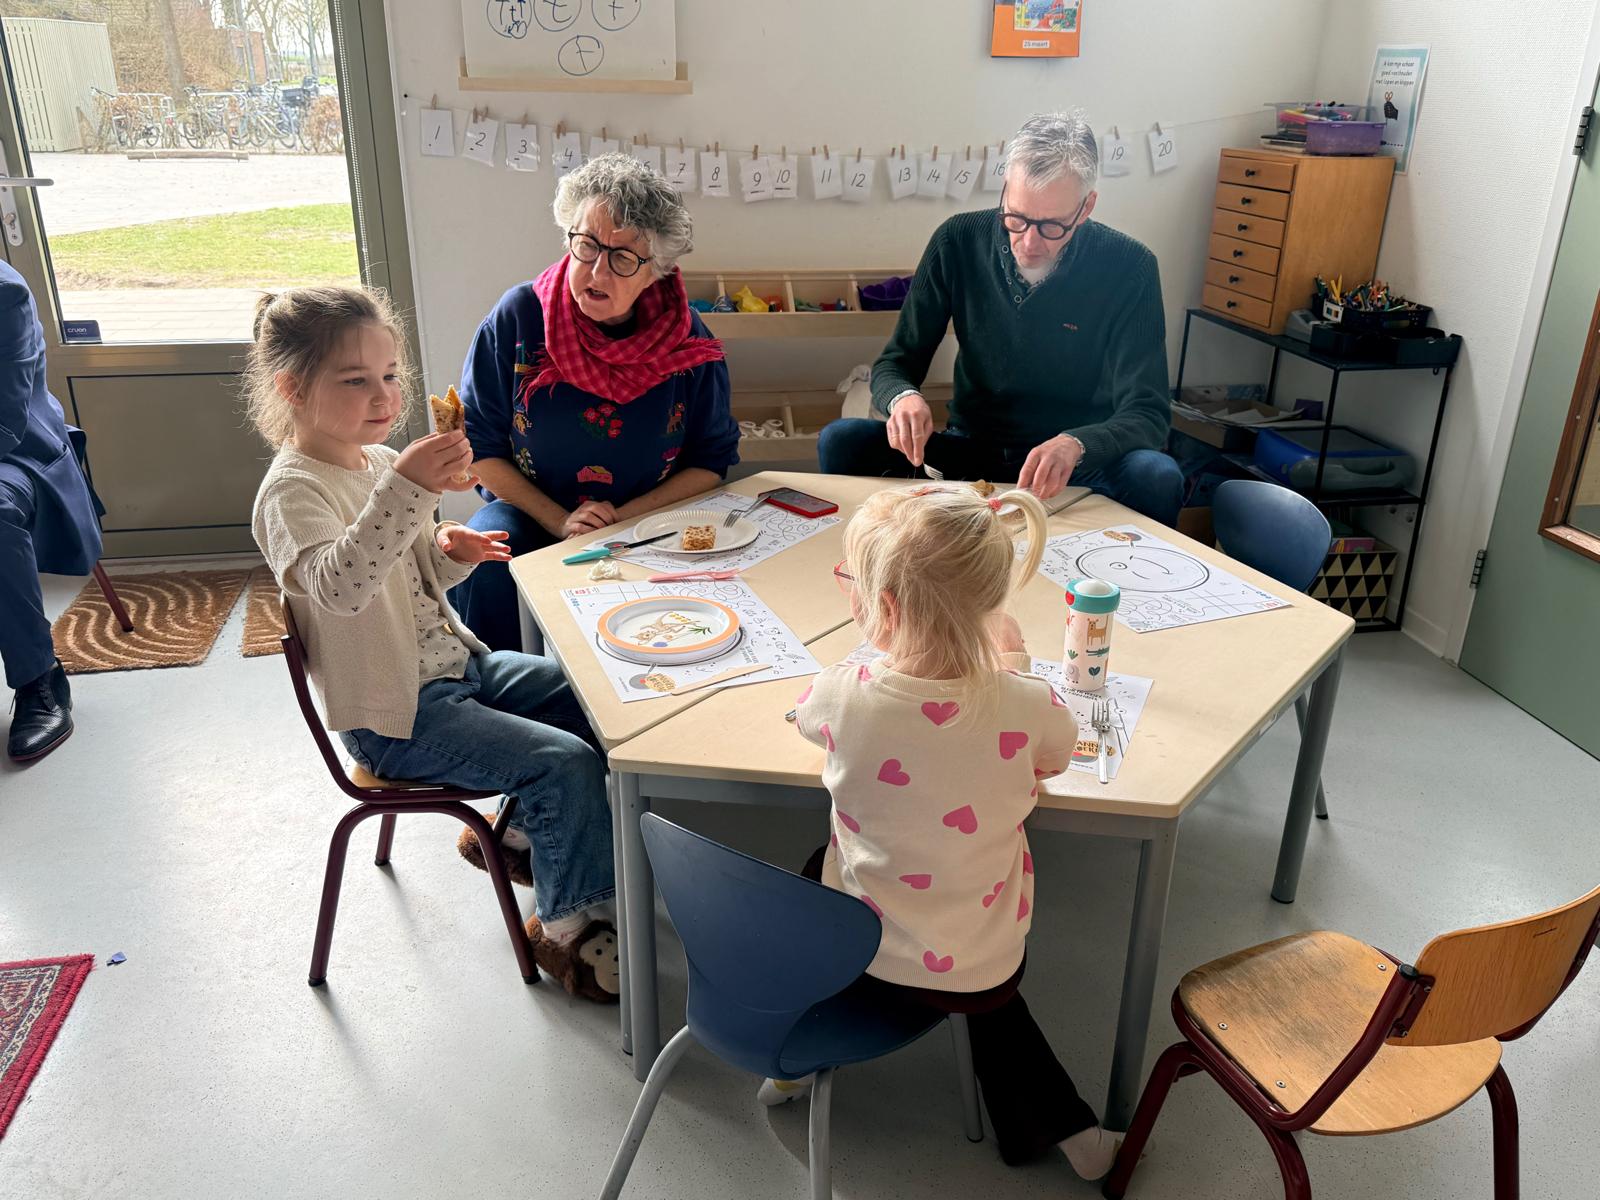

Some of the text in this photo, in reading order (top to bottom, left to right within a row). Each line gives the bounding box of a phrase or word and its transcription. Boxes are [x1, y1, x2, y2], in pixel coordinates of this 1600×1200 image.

[475, 132, 487, 147] 2
[518, 139, 528, 154] 3
[564, 147, 573, 162] 4
[1111, 146, 1125, 160] 19
[1158, 140, 1173, 158] 20
[677, 162, 686, 177] 7
[711, 166, 721, 182] 8
[776, 169, 791, 184] 10
[820, 168, 832, 184] 11
[898, 167, 912, 184] 13
[926, 168, 940, 183] 14
[954, 169, 971, 184] 15
[992, 162, 1006, 176] 16
[753, 171, 762, 187] 9
[850, 173, 866, 188] 12
